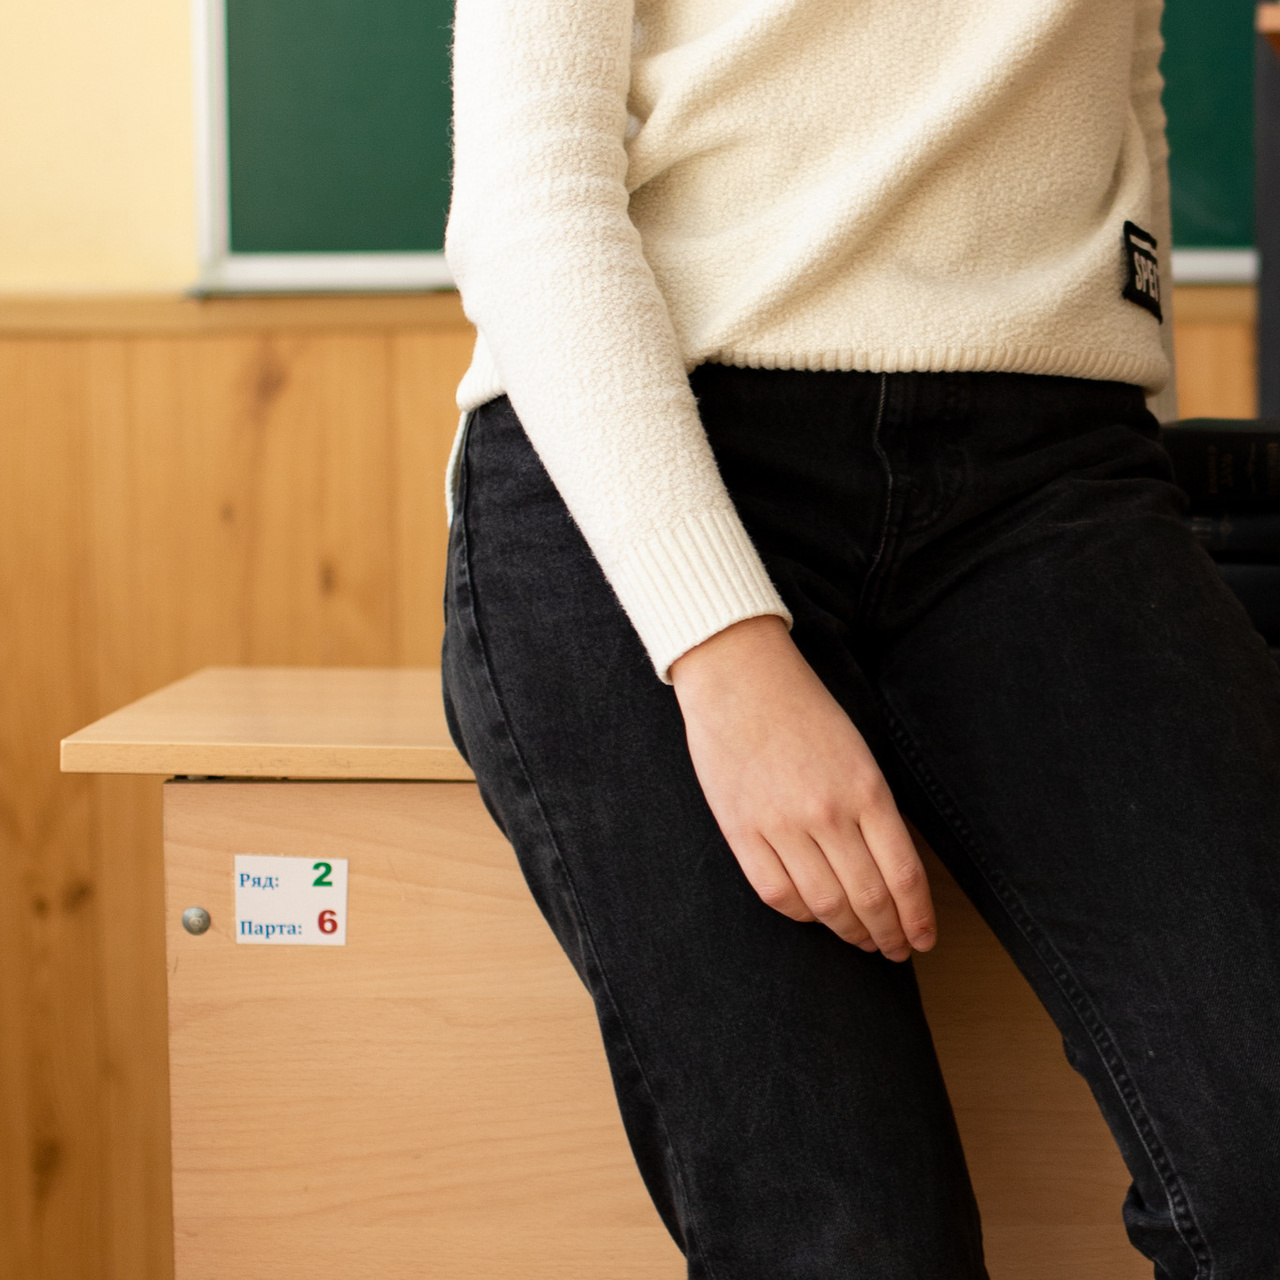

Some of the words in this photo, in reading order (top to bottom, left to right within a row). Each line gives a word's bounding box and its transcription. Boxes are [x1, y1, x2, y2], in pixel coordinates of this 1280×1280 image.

[239, 873, 279, 890] Ряд:
[312, 861, 333, 887] 2
[240, 920, 302, 939] Парта:
[317, 909, 338, 935] 6
